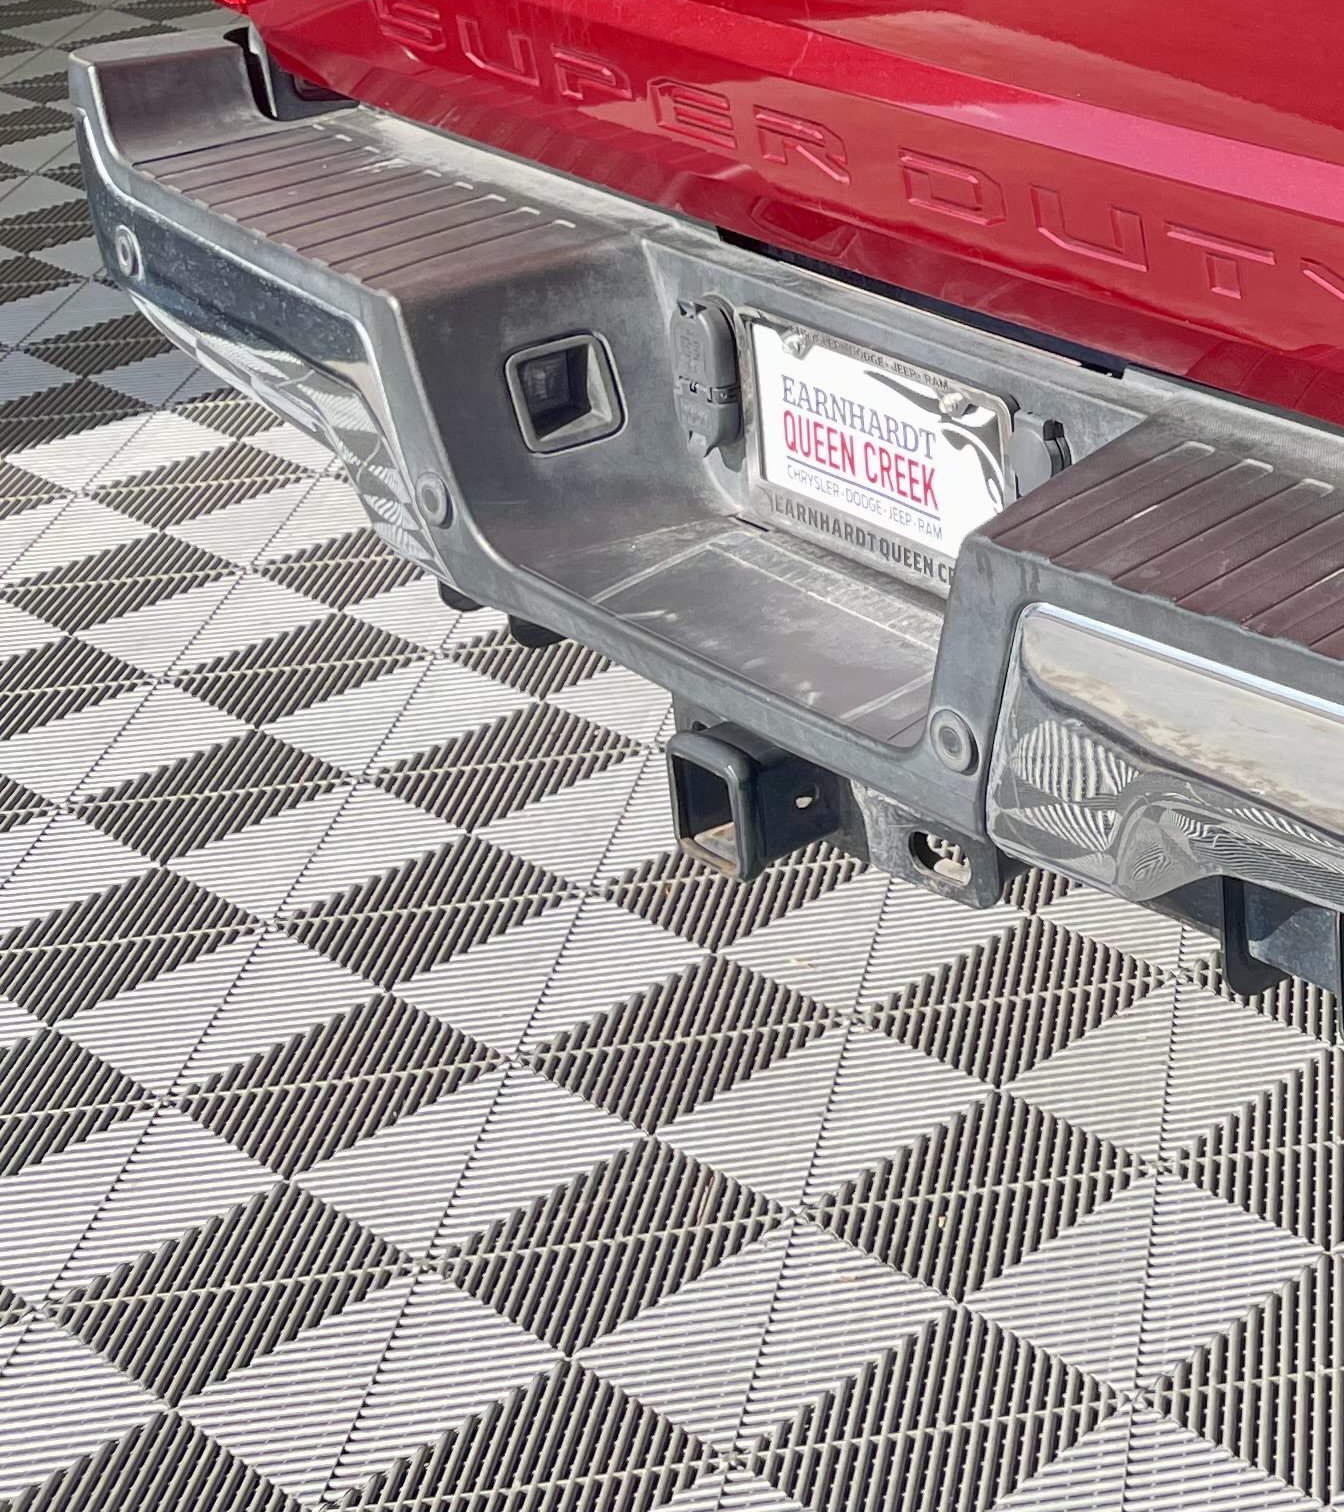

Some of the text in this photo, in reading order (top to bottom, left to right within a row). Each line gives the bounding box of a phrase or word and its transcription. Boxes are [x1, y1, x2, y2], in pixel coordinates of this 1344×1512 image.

[781, 373, 937, 460] EARNHARDT
[891, 362, 916, 378] JEEP
[924, 373, 949, 390] RAM
[783, 409, 856, 477] QUEEN
[863, 441, 940, 511] CREEK
[787, 464, 943, 541] CHRYSLER DODGE JEEP RAM
